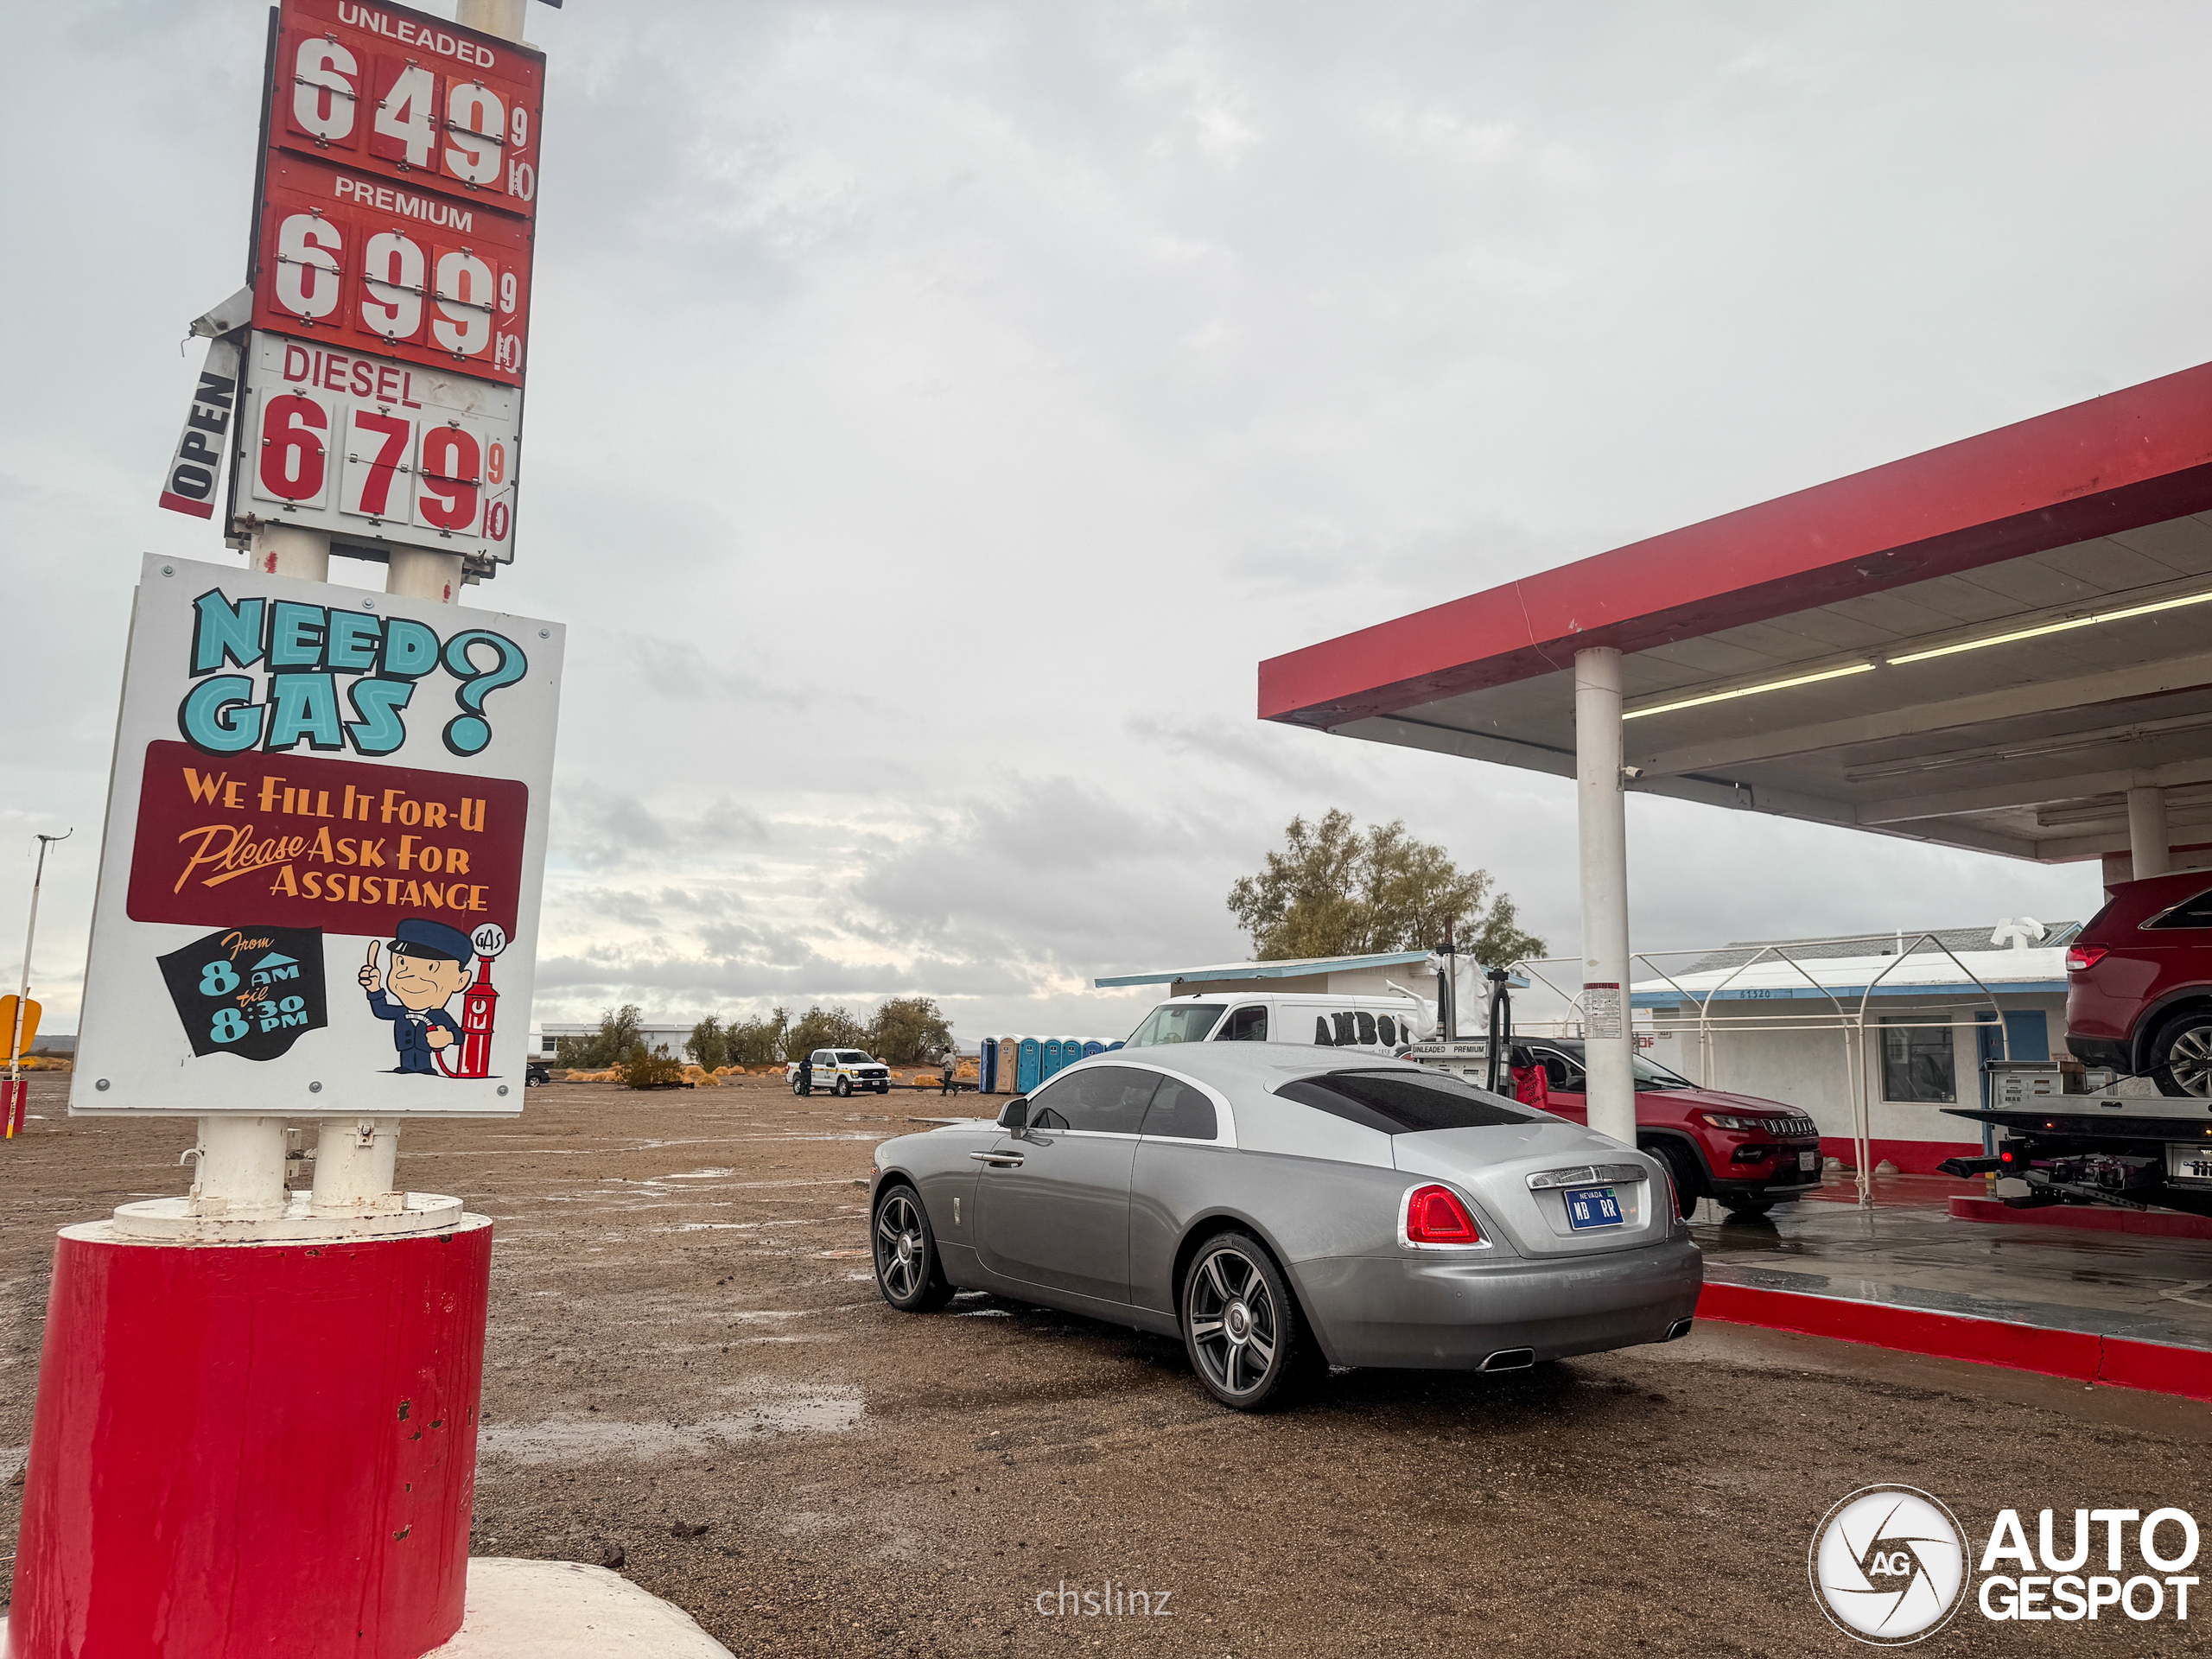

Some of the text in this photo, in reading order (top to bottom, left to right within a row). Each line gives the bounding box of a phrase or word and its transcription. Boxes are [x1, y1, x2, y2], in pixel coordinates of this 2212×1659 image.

[338, 1, 495, 68] UNLEADED
[293, 38, 505, 185] 649
[334, 175, 473, 232] PREMIUM
[276, 213, 493, 355] 699
[283, 344, 422, 410] DIESEL
[172, 372, 235, 500] OPEN
[259, 394, 481, 531] 679
[178, 671, 417, 756] GAS
[182, 766, 486, 833] WE FILL IT FOR-U
[174, 823, 471, 895] Please ASK FOR
[270, 865, 489, 912] ASSISTANCE
[221, 931, 275, 961] From
[475, 929, 503, 950] GAS
[199, 960, 300, 997] 8 AM
[210, 995, 308, 1044] 8:30 PM
[1526, 1082, 1538, 1091] OUT
[1600, 1198, 1617, 1217] RR
